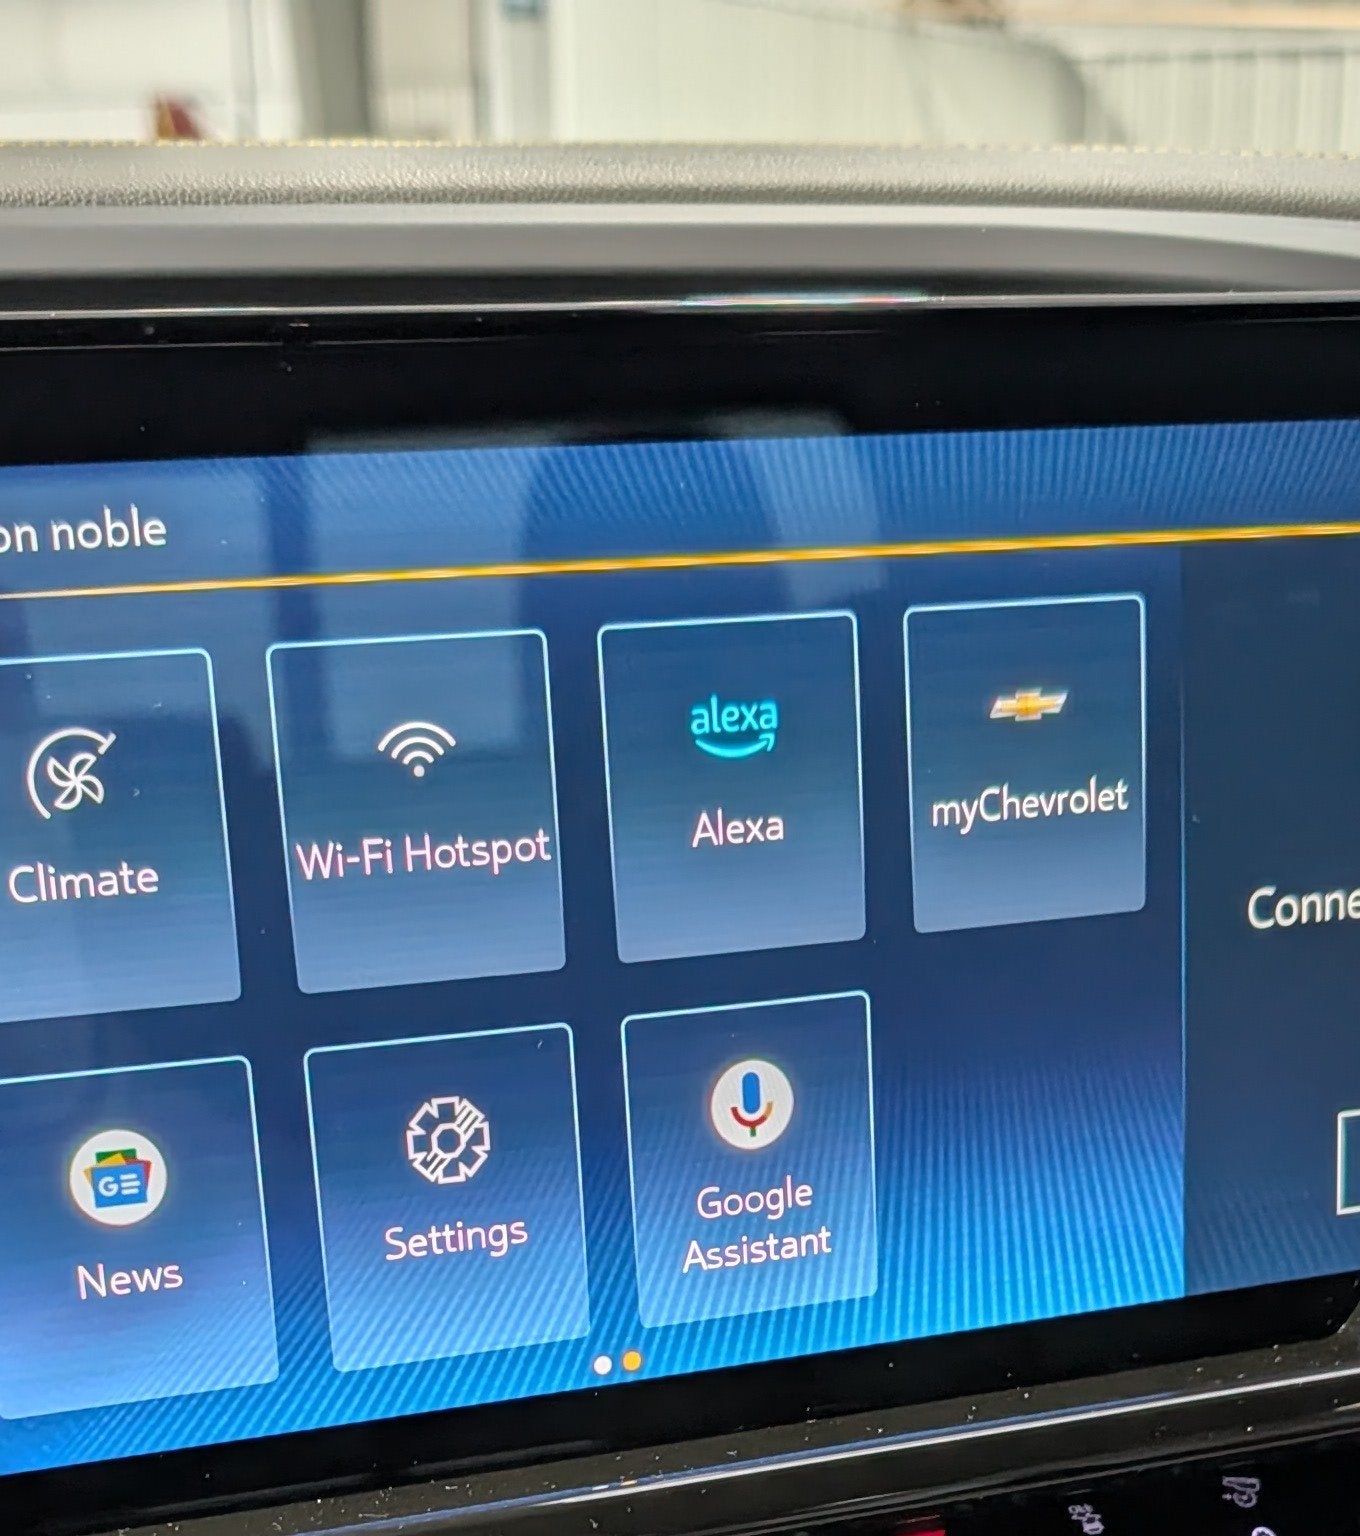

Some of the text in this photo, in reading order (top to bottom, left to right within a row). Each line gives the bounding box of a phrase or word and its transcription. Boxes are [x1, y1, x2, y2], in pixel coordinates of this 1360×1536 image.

[51, 506, 166, 550] noble
[691, 695, 776, 733] alexa
[932, 779, 1128, 833] myChevrolet
[693, 811, 783, 846] Alexa
[295, 831, 550, 880] Wi-Fi Hotspot
[8, 865, 158, 903] Climate
[696, 1176, 812, 1220] Google
[385, 1220, 528, 1260] Settings
[682, 1227, 831, 1273] Assistant
[77, 1262, 182, 1299] News
